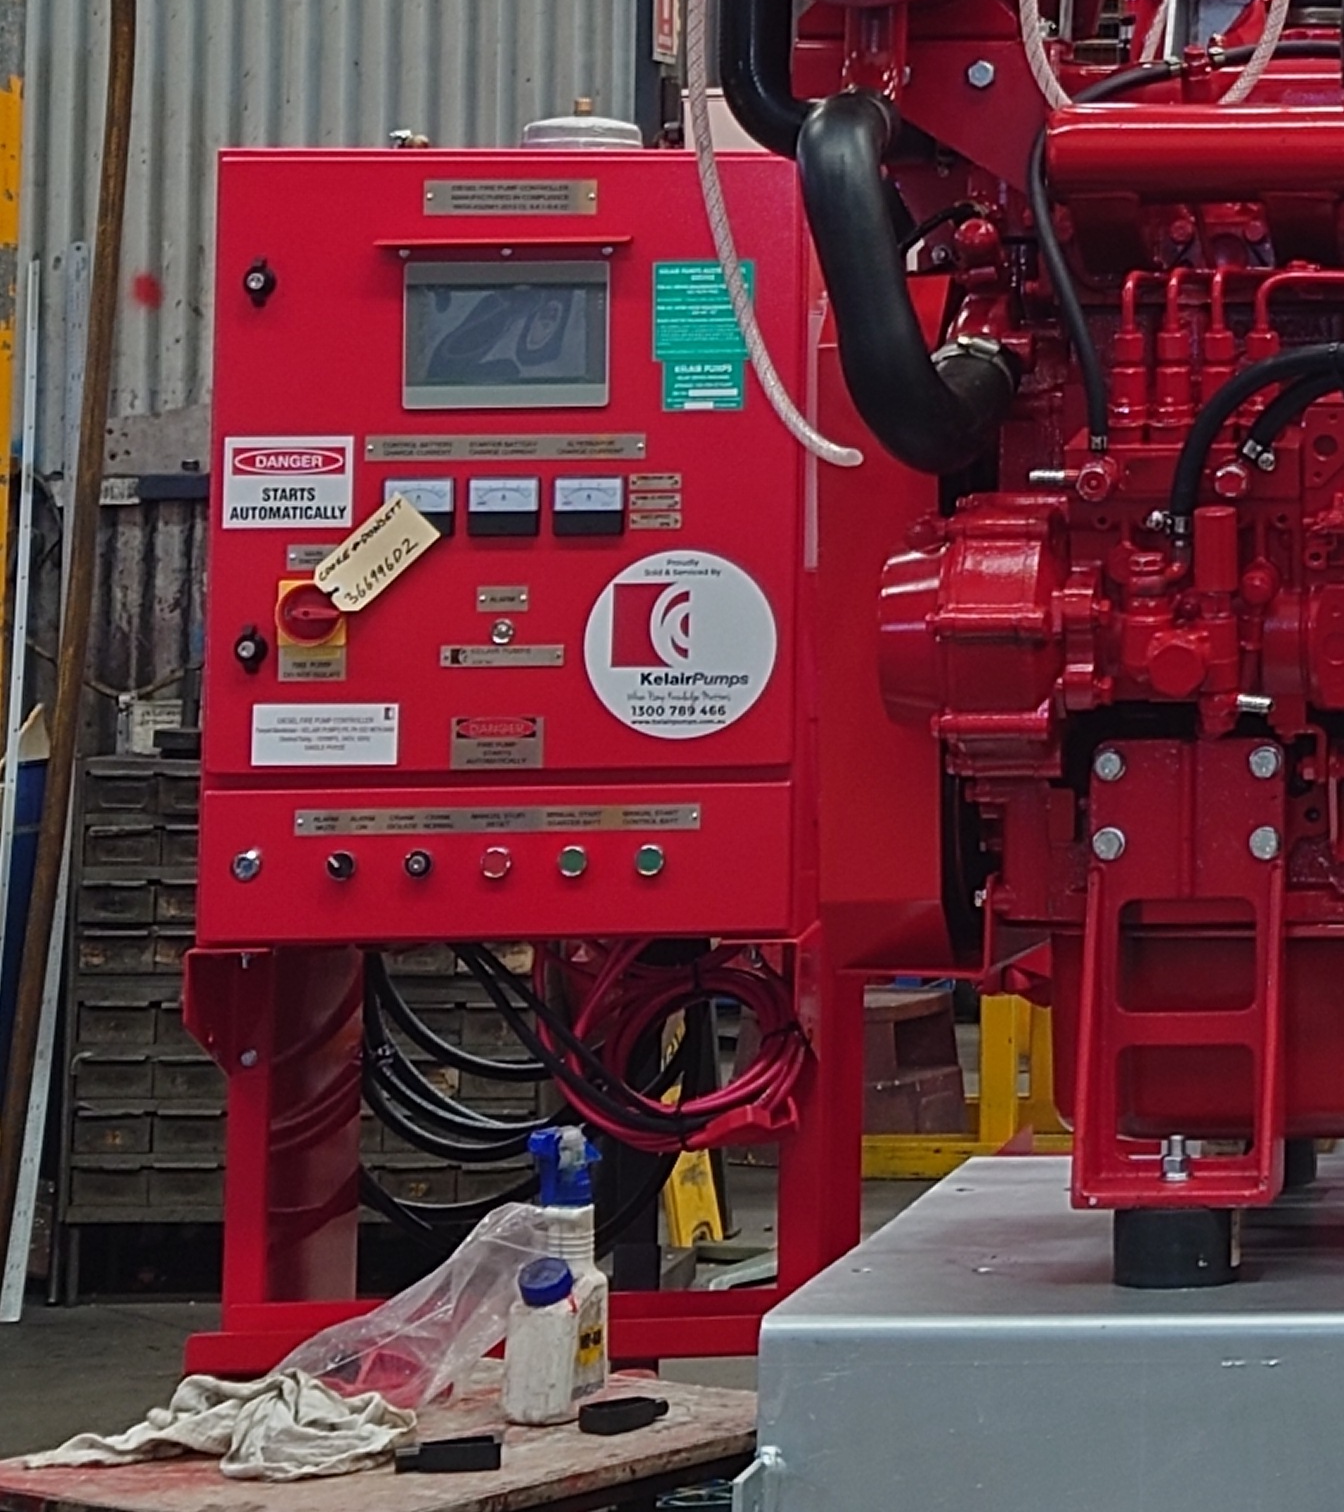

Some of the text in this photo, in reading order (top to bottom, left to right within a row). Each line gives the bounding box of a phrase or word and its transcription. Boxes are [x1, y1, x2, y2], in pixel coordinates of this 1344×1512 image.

[255, 455, 323, 469] DANGER
[262, 487, 316, 502] STARTS
[230, 506, 347, 521] AUTOMATICALLY
[667, 559, 699, 568] Proudly
[644, 568, 663, 576] Sold
[673, 568, 709, 576] Serviced
[710, 568, 722, 577] By
[640, 672, 749, 688] KelairPumps
[631, 705, 727, 717] 1300 789 466
